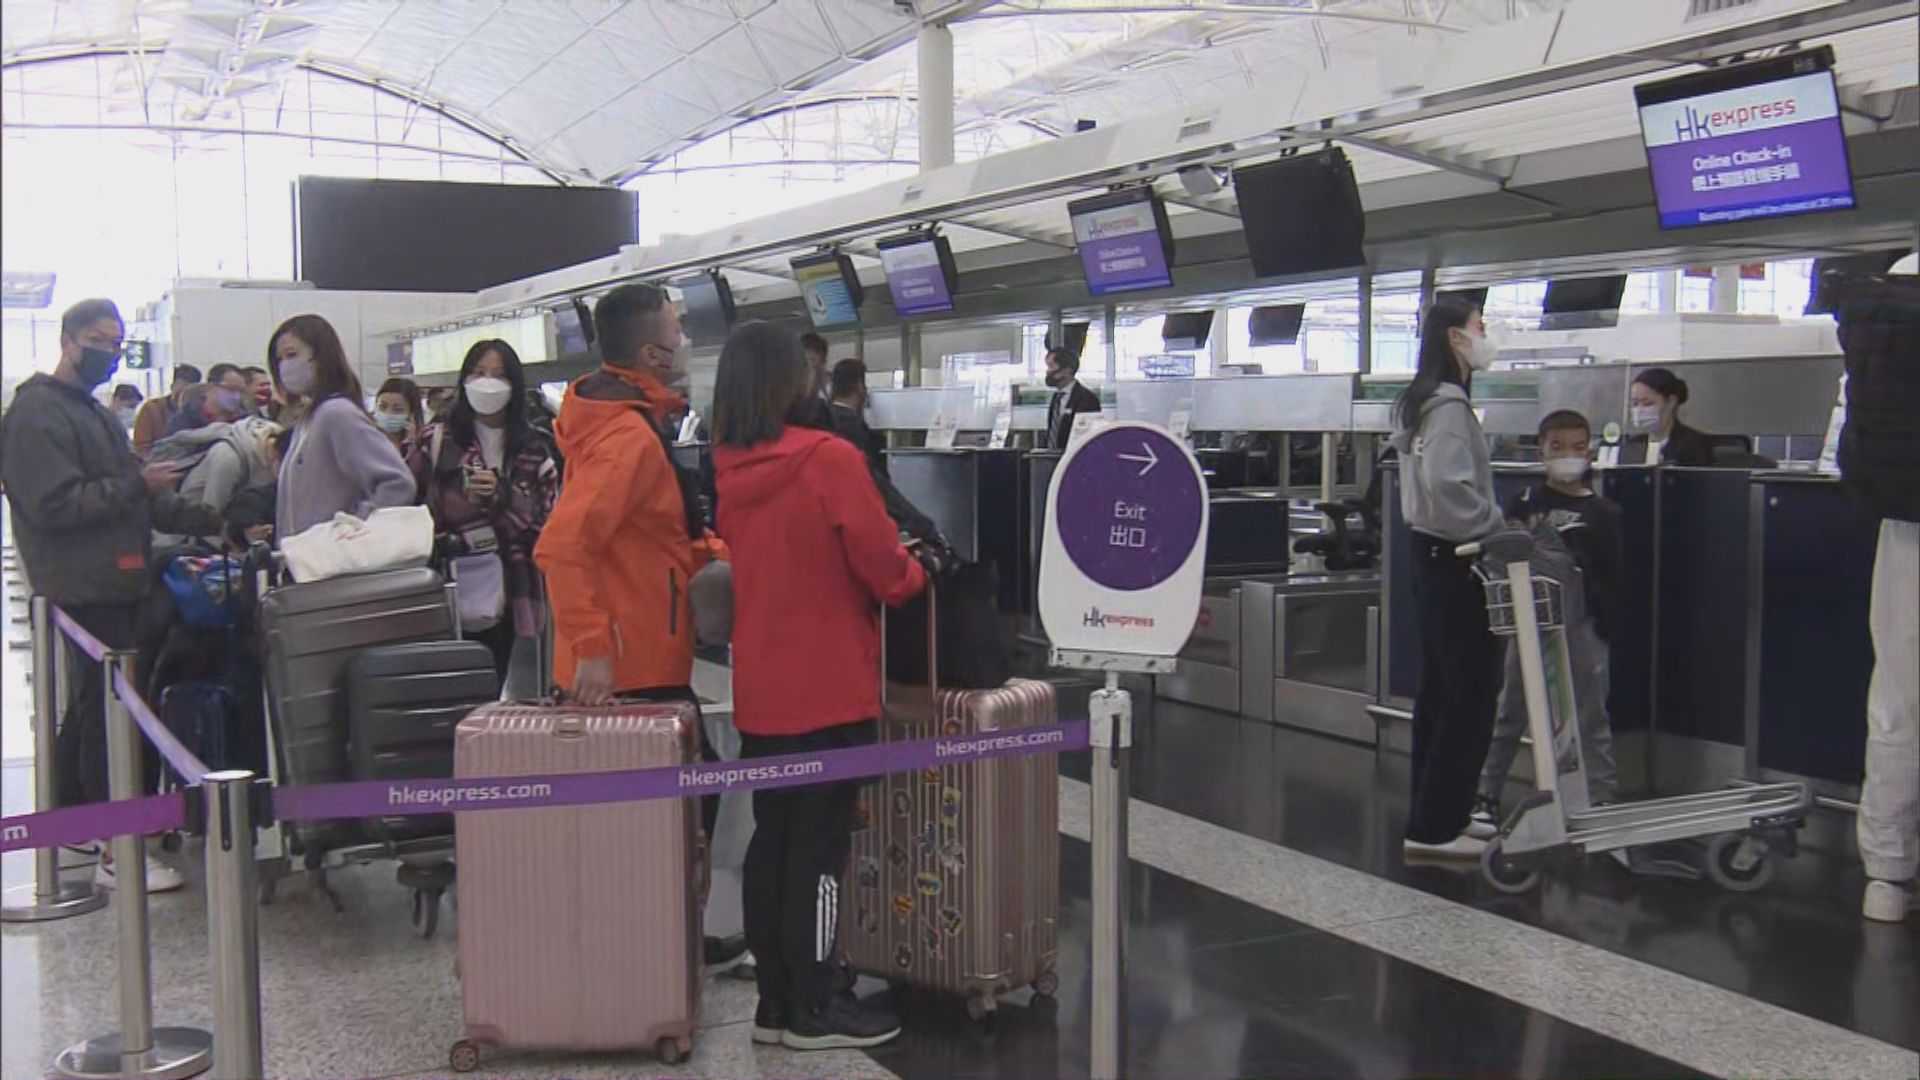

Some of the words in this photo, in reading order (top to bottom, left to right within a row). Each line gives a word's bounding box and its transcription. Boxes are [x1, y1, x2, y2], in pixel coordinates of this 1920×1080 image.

[1114, 500, 1147, 521] Exit
[1110, 525, 1146, 547] 出口
[936, 729, 1063, 757] hkexpress.com
[679, 760, 823, 787] hkexpress.com
[388, 783, 551, 805] hkexpress.com
[0, 824, 28, 841] m
